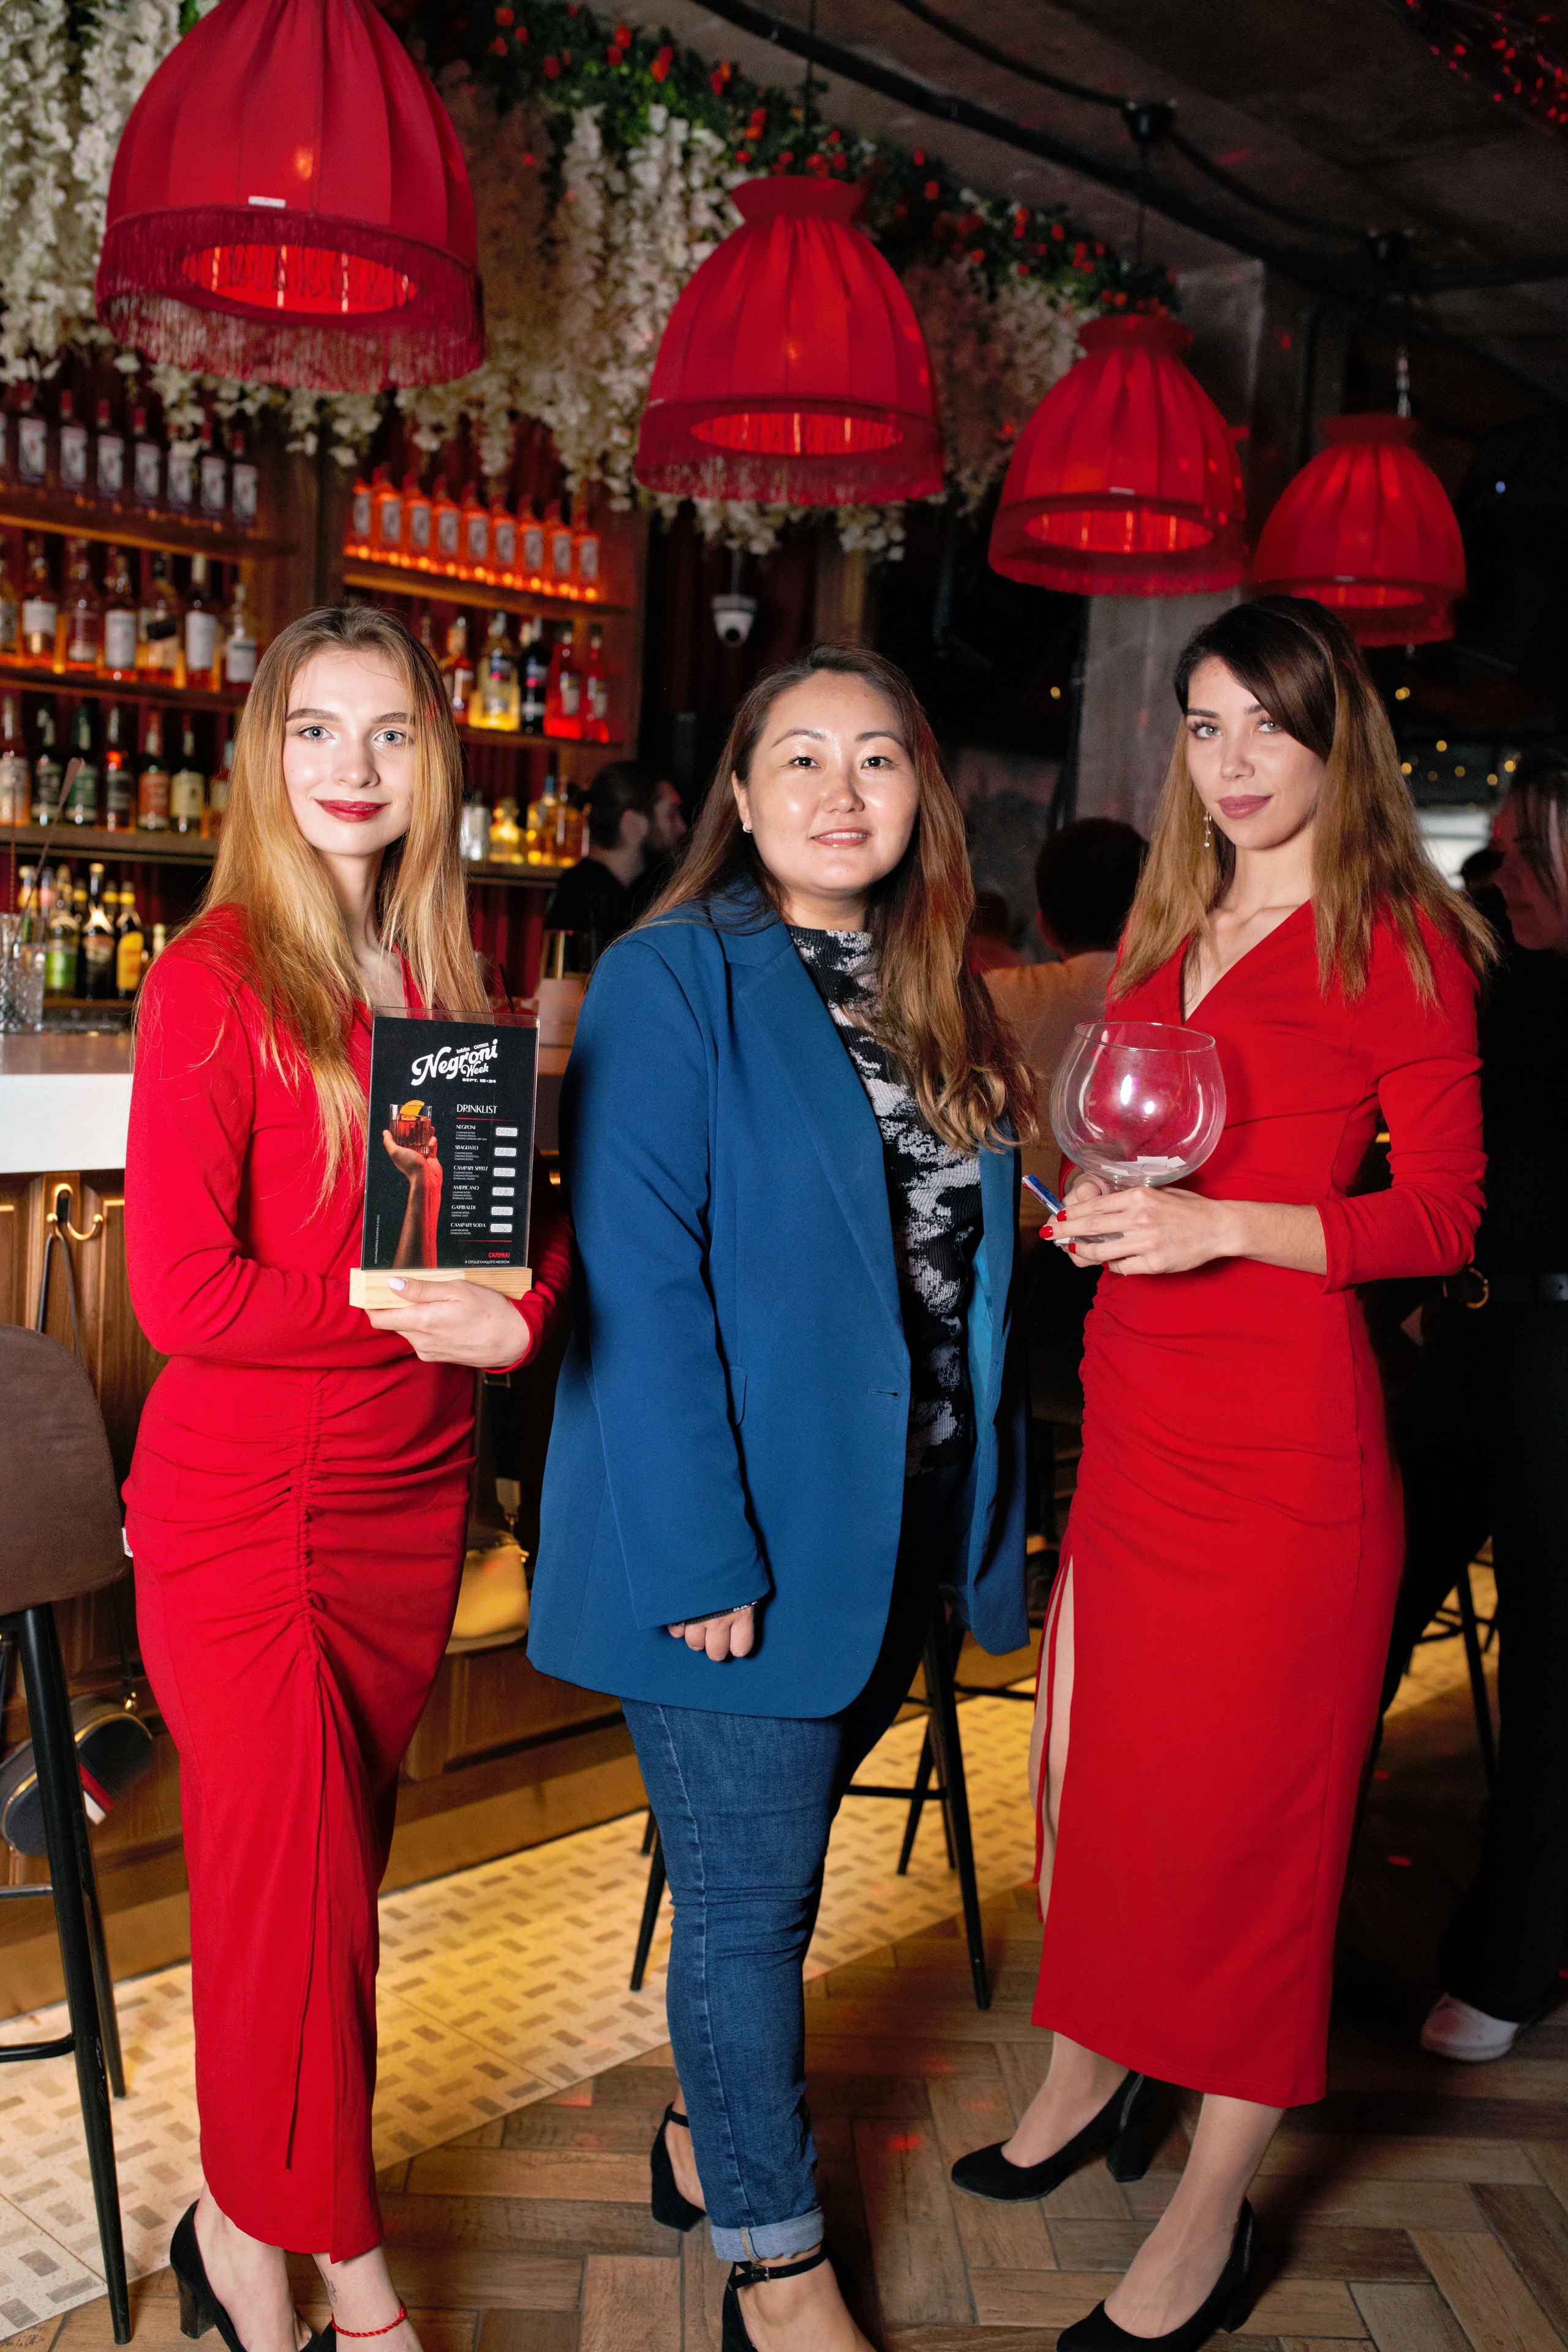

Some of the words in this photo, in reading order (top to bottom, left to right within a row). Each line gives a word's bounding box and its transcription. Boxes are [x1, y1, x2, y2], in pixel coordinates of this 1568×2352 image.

[411, 1039, 498, 1086] Negroni
[461, 1061, 489, 1077] Week
[456, 1104, 497, 1114] DRINKLIST
